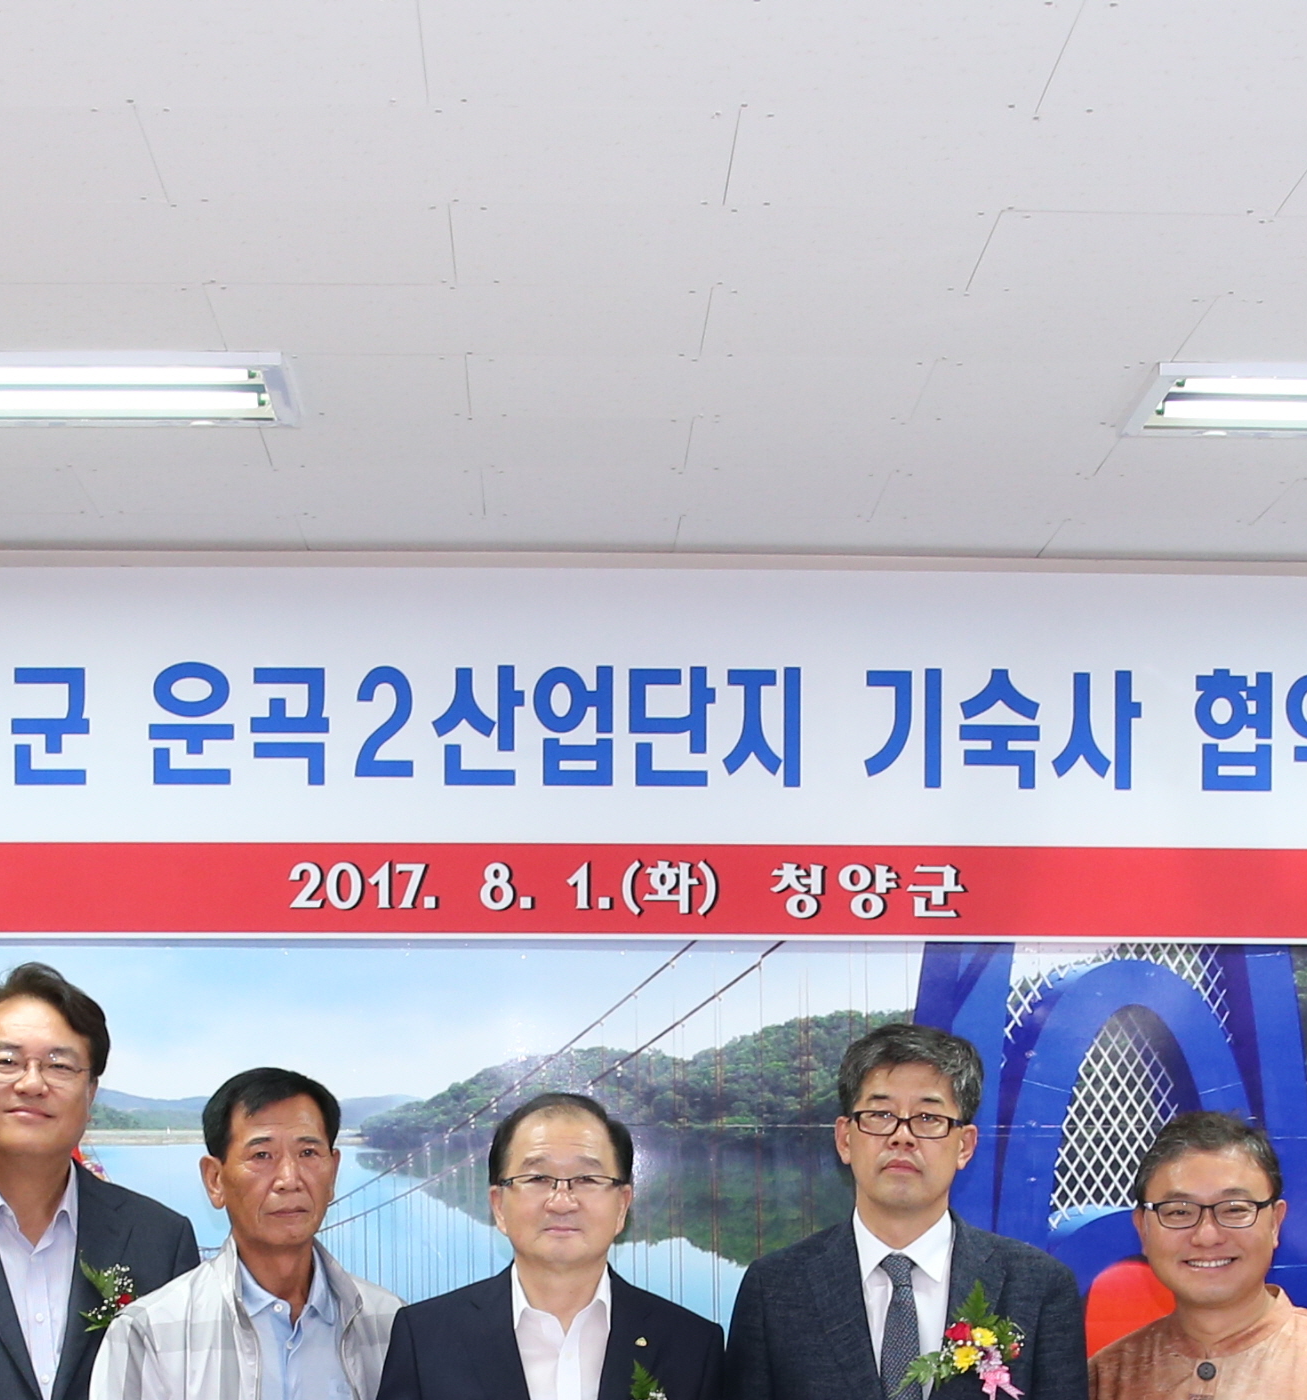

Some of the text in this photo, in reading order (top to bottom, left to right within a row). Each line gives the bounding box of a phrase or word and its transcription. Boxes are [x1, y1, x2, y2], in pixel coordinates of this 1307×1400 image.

[148, 661, 802, 788] 운곡2산업단지
[864, 667, 1143, 791] 기숙사
[289, 860, 966, 919] 2017. 8. 1.(화) 청양군
